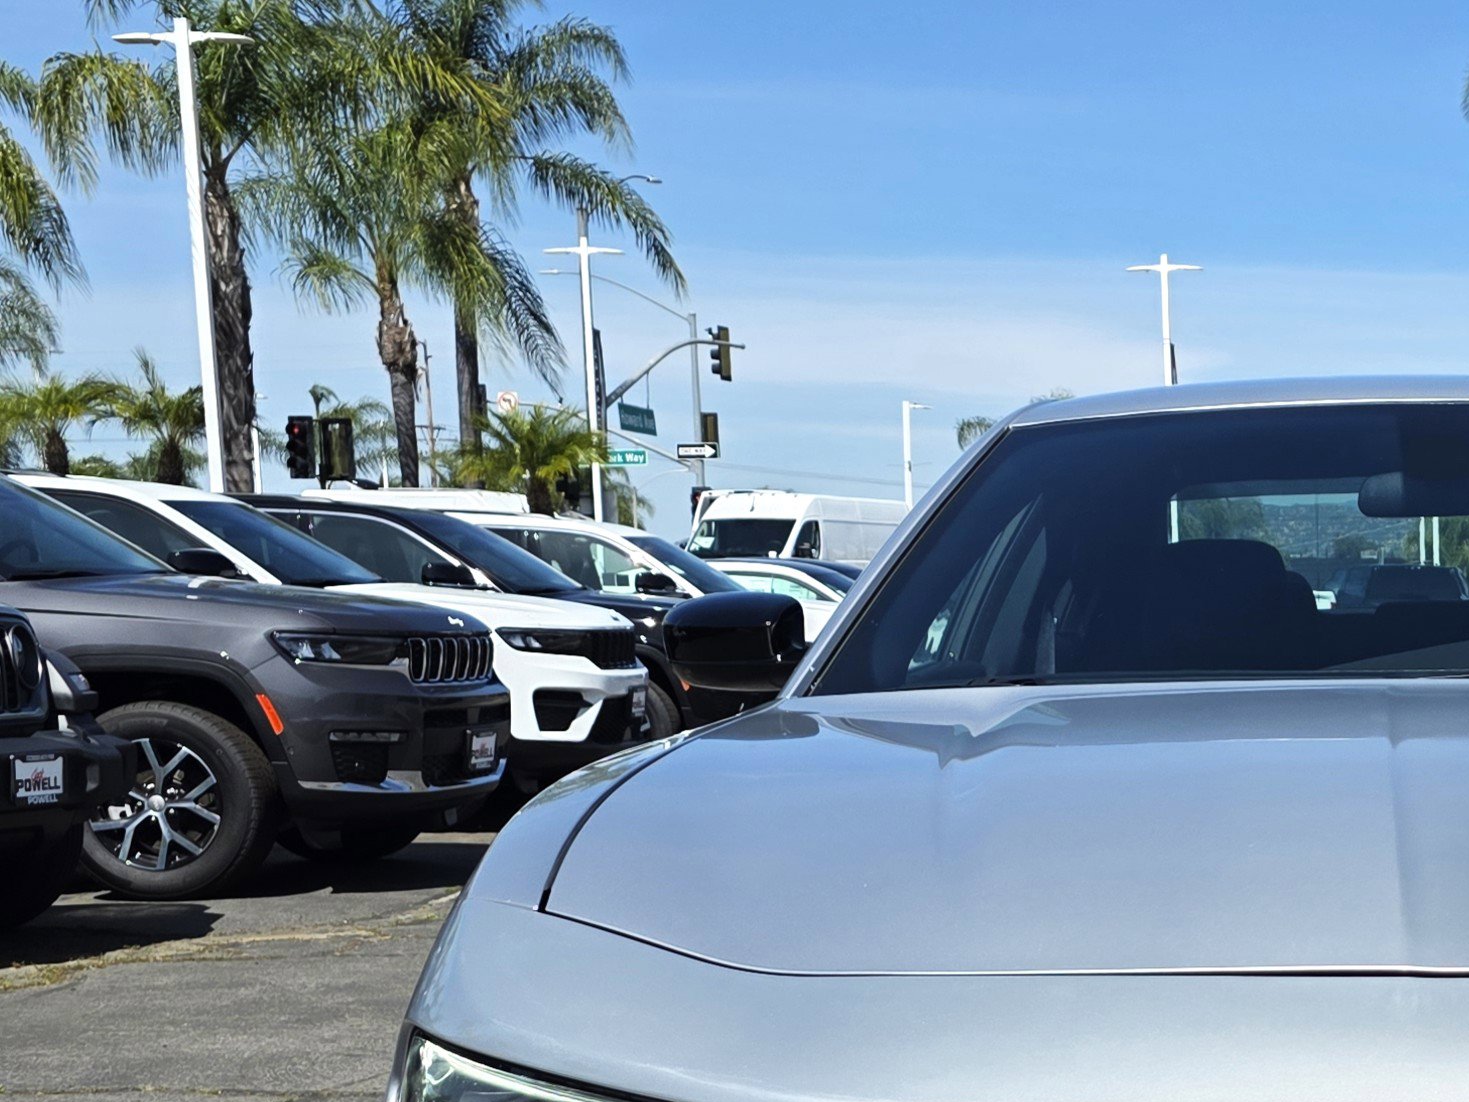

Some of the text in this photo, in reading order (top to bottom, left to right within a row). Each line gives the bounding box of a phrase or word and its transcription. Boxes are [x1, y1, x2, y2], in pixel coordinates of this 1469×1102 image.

[625, 453, 644, 464] Way
[16, 776, 60, 792] POWELL
[28, 793, 58, 805] POWELL
